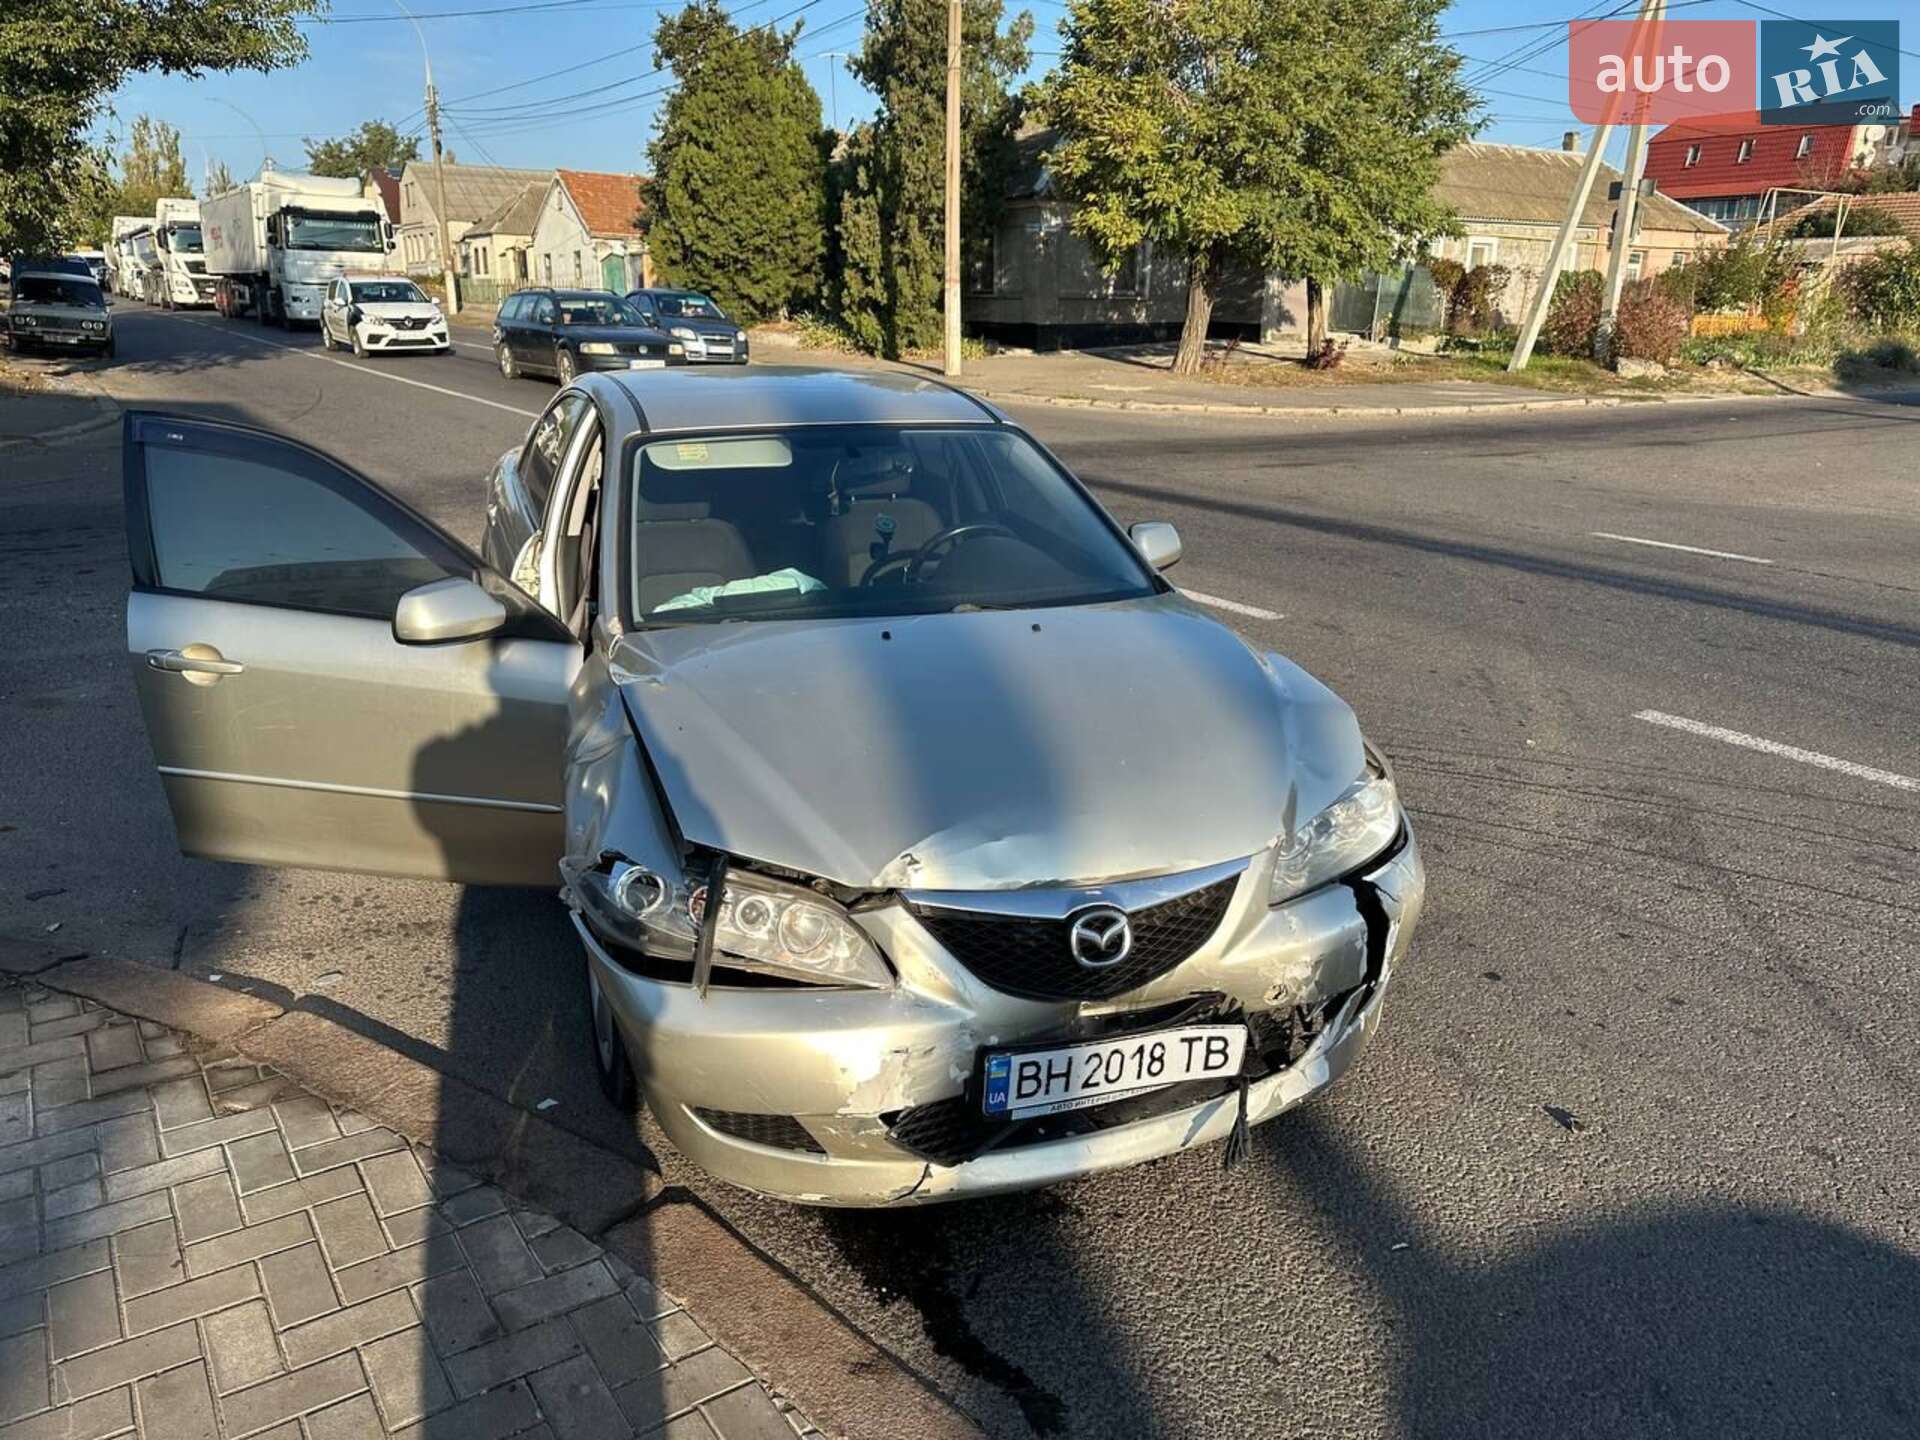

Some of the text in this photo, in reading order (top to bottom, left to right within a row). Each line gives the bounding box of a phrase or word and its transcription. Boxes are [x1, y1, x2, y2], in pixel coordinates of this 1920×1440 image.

[1016, 1035, 1229, 1099] BH 2018 TB
[989, 1092, 1006, 1105] UA
[1051, 1100, 1073, 1112] АВТО
